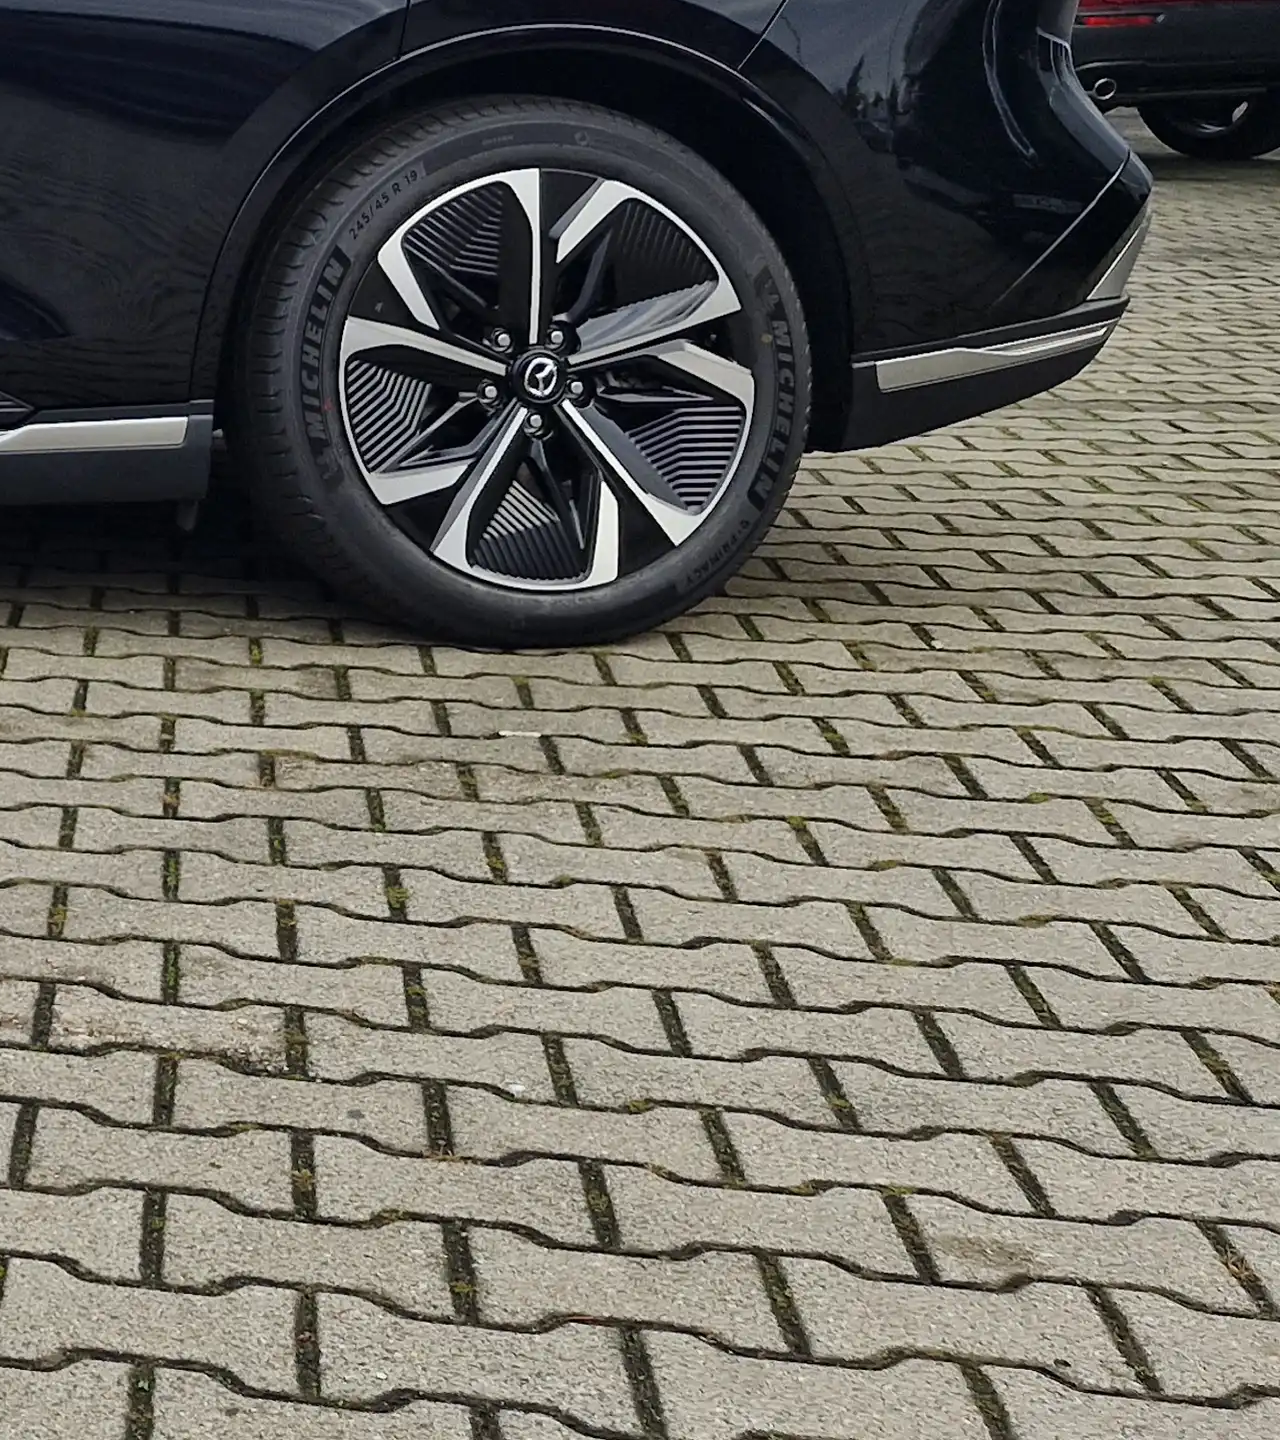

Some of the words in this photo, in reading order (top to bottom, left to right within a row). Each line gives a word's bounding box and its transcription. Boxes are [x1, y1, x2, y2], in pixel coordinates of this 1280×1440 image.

[349, 191, 389, 240] 245/45
[391, 182, 402, 195] R
[404, 169, 418, 185] 19
[300, 256, 344, 440] MICHELIN
[759, 319, 795, 498] MICHELIN
